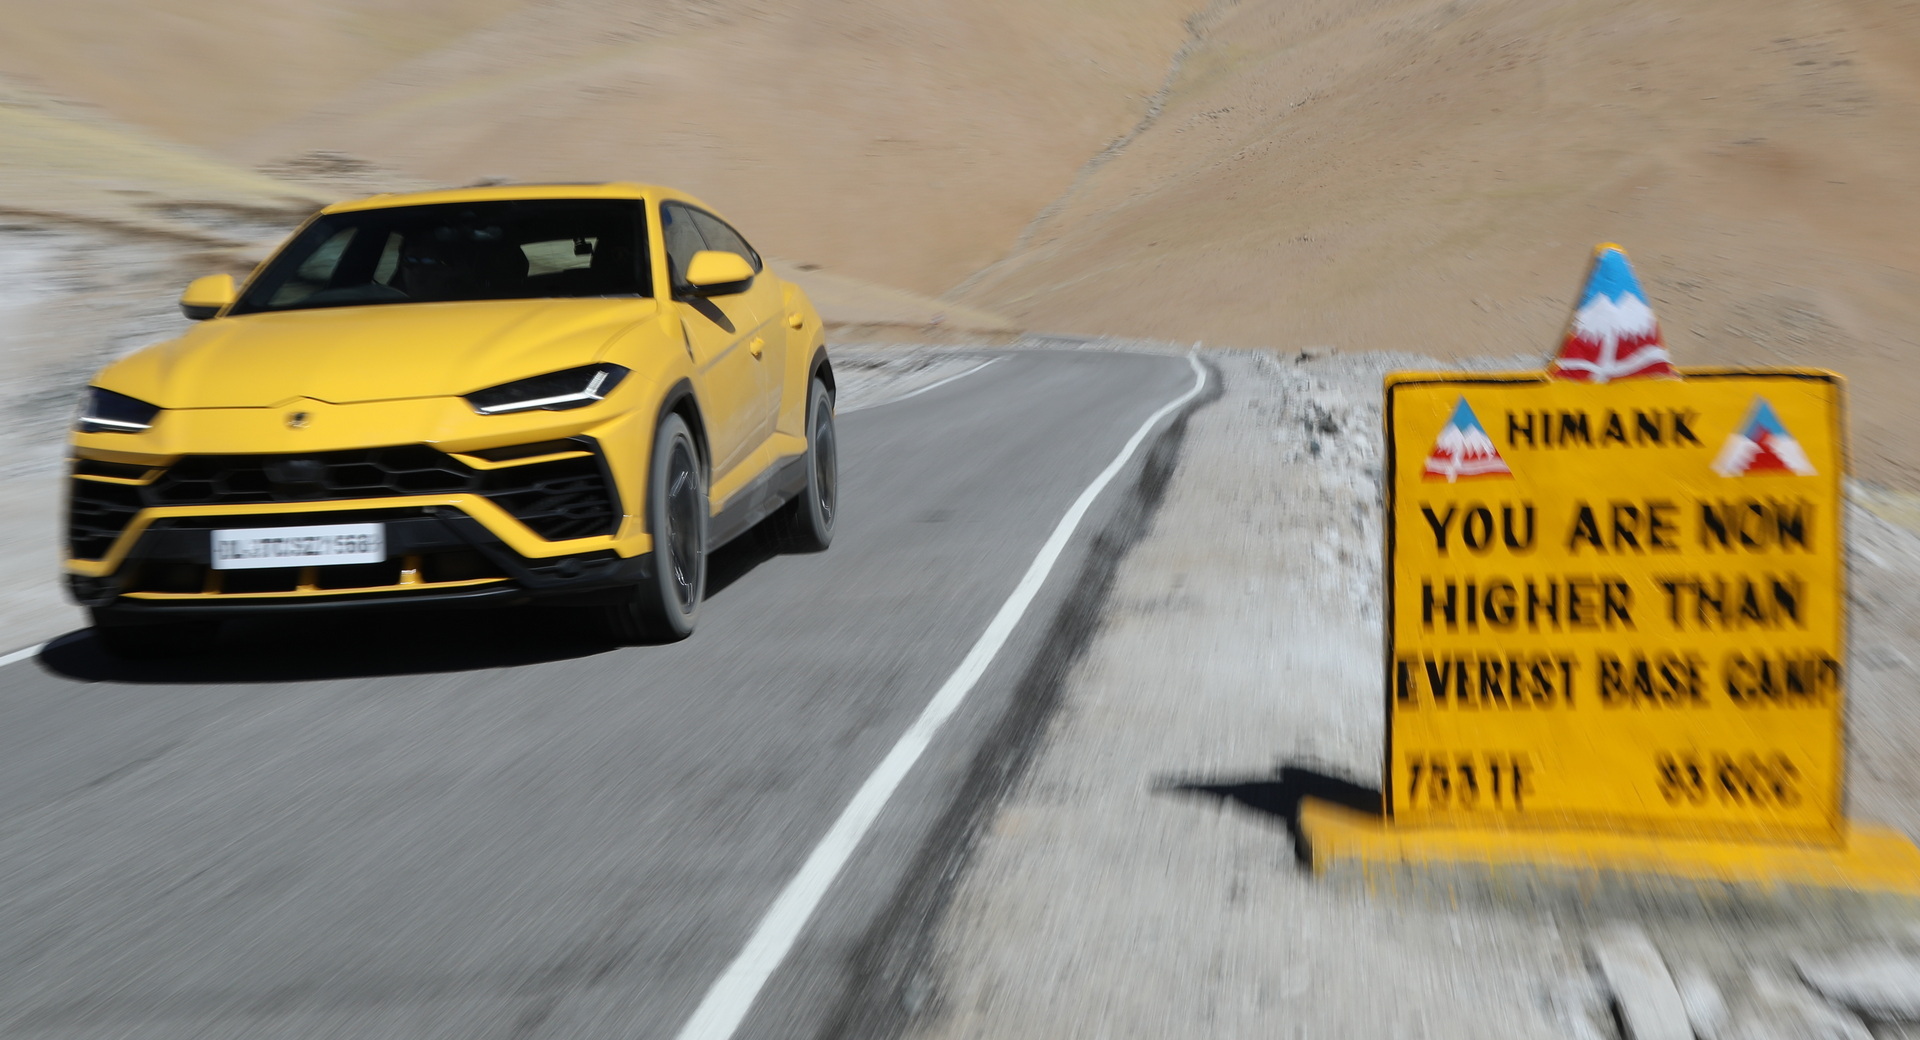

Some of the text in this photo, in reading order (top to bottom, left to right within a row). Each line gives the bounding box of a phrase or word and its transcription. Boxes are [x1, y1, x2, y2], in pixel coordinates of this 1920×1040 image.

[1504, 409, 1704, 450] HIMANK
[1420, 497, 1818, 557] YOU ARE NOW
[1420, 574, 1809, 633] HIGHER THAN
[1397, 648, 1842, 710] EVEREST BASE CAMP
